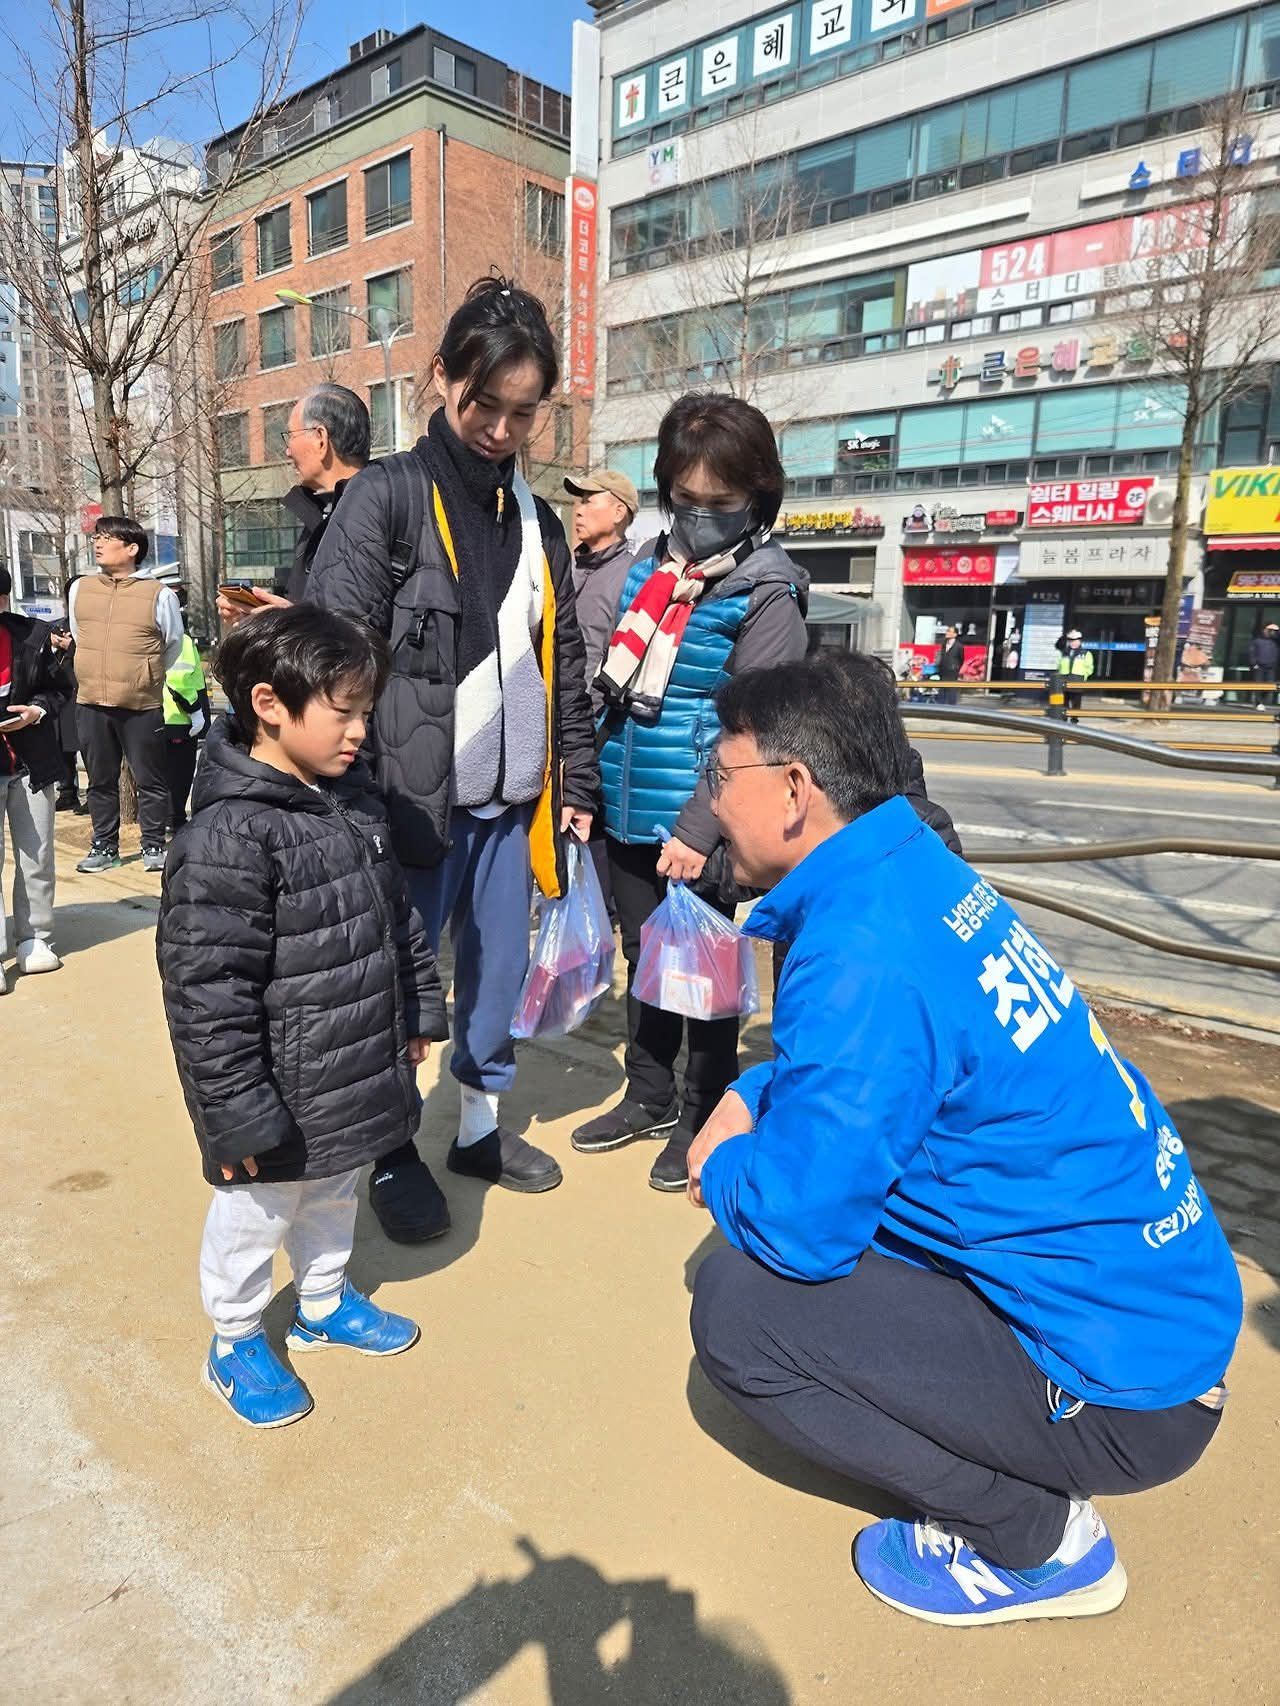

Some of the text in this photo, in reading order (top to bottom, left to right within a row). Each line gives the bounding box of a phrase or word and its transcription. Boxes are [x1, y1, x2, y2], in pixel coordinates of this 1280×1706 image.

[990, 241, 1045, 283] 524
[1030, 480, 1120, 504] 쉼터 힐링
[1214, 472, 1280, 499] VIK
[1031, 502, 1115, 524] 스웨디시
[1041, 545, 1152, 565] 늘봄프라자
[944, 1558, 1015, 1605] N
